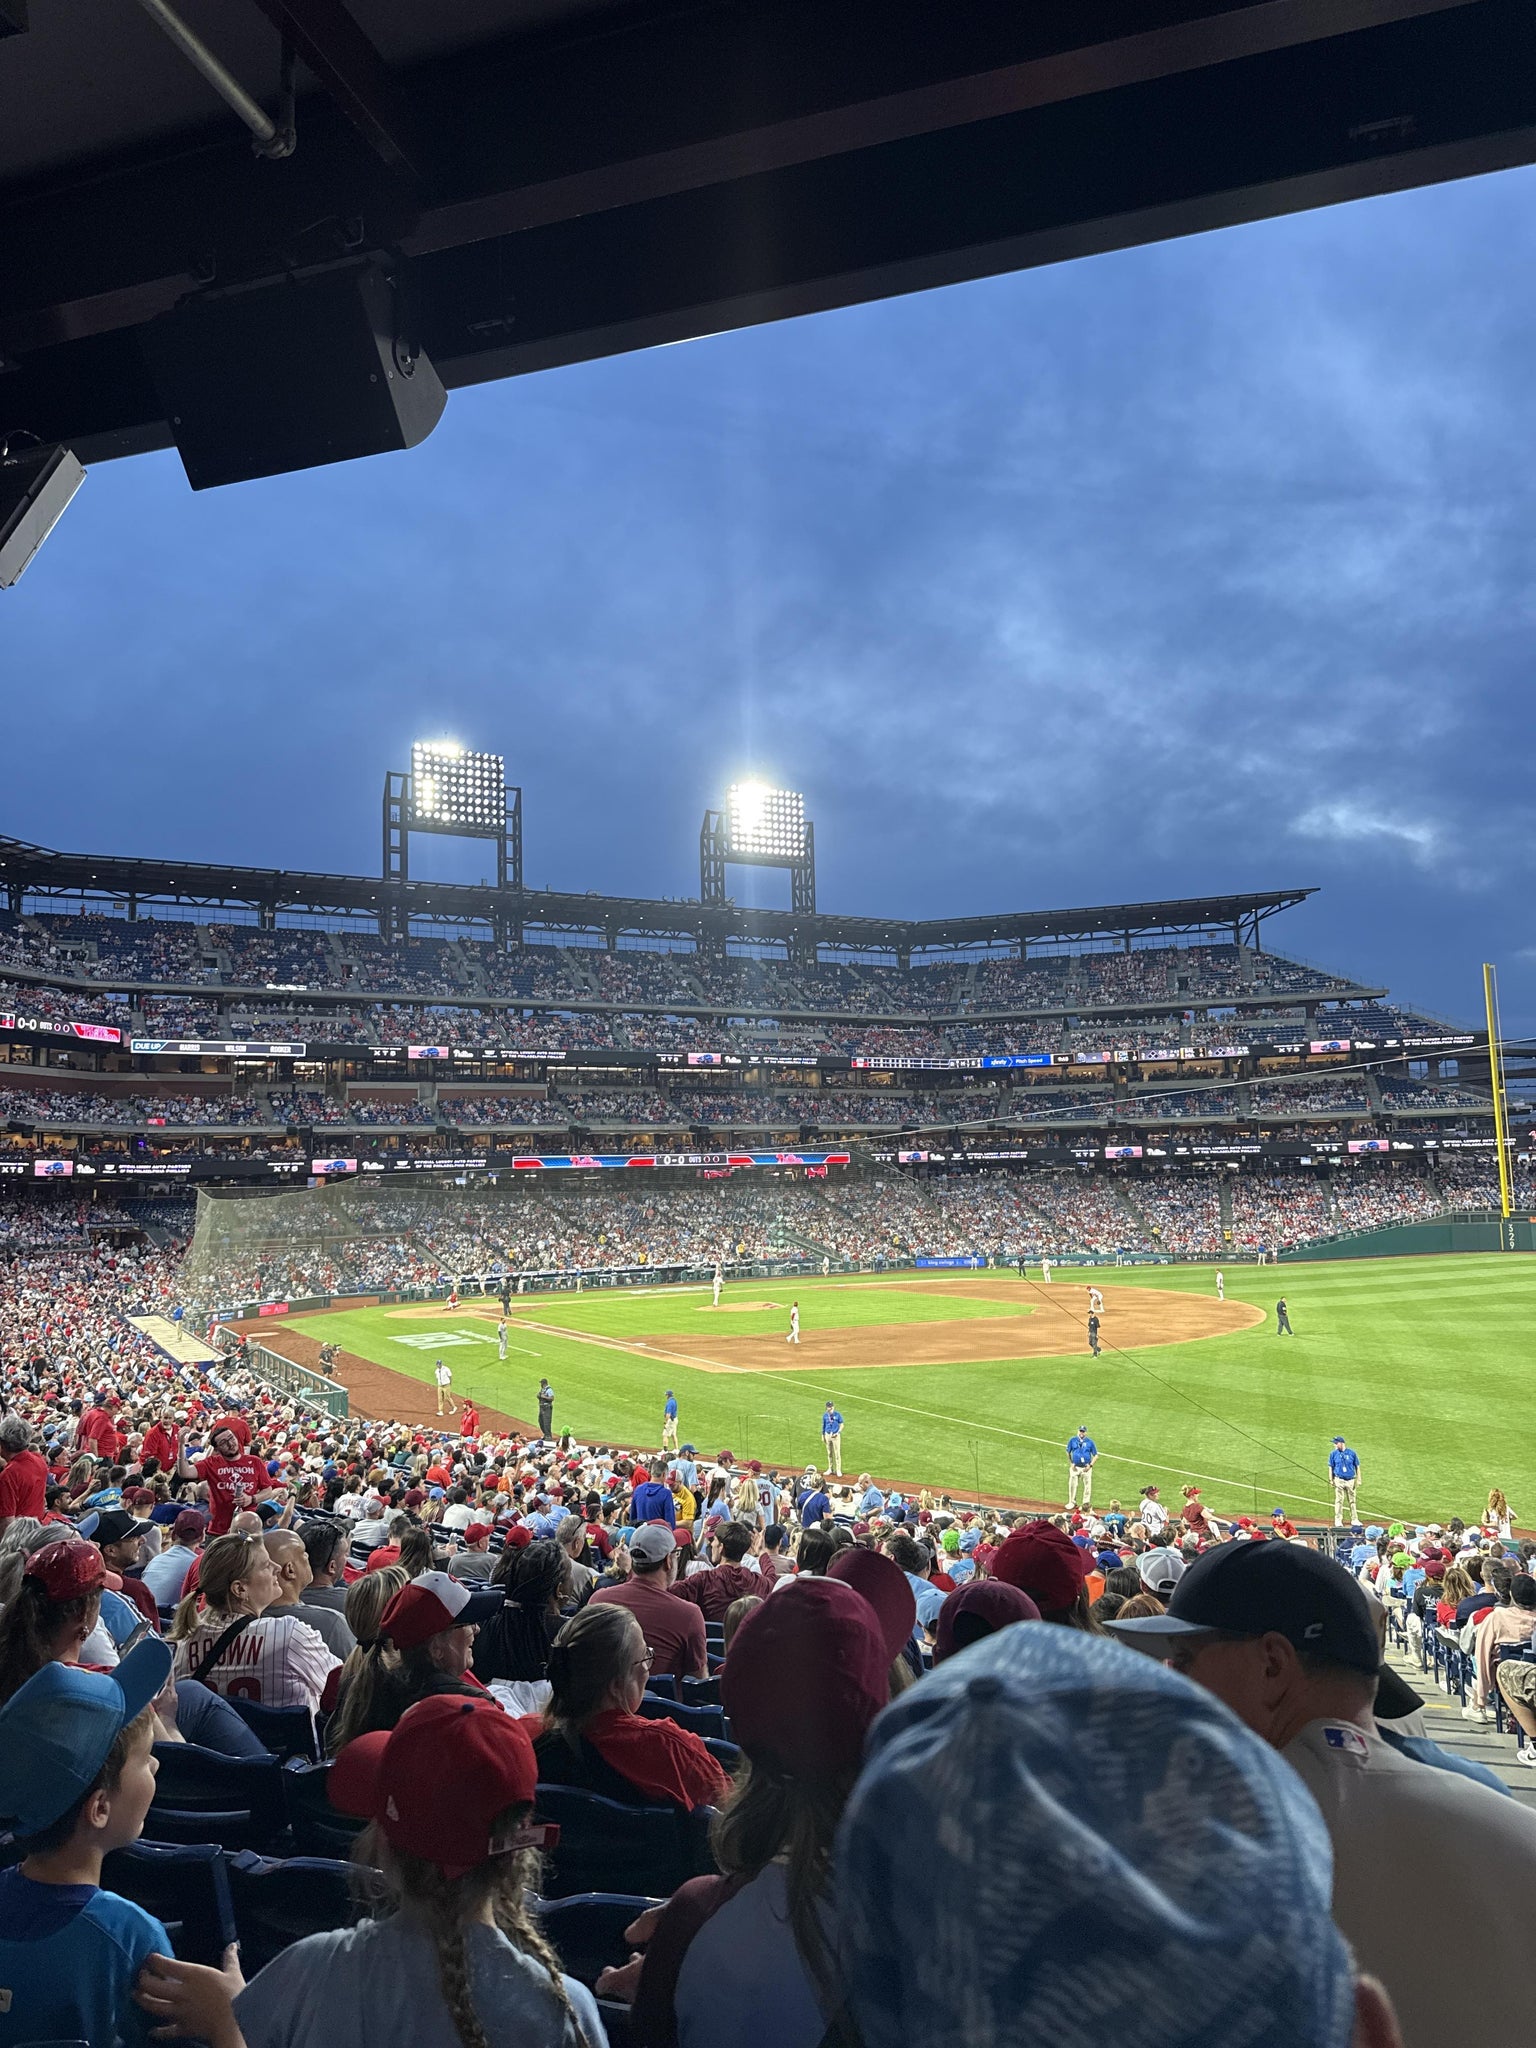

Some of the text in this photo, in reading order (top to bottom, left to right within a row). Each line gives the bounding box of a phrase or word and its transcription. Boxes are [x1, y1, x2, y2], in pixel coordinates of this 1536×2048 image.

[18, 1018, 37, 1030] 0-0
[664, 1155, 702, 1165] 0-0 OUTS
[217, 1466, 254, 1475] DIVISION
[190, 1635, 263, 1670] BRWN
